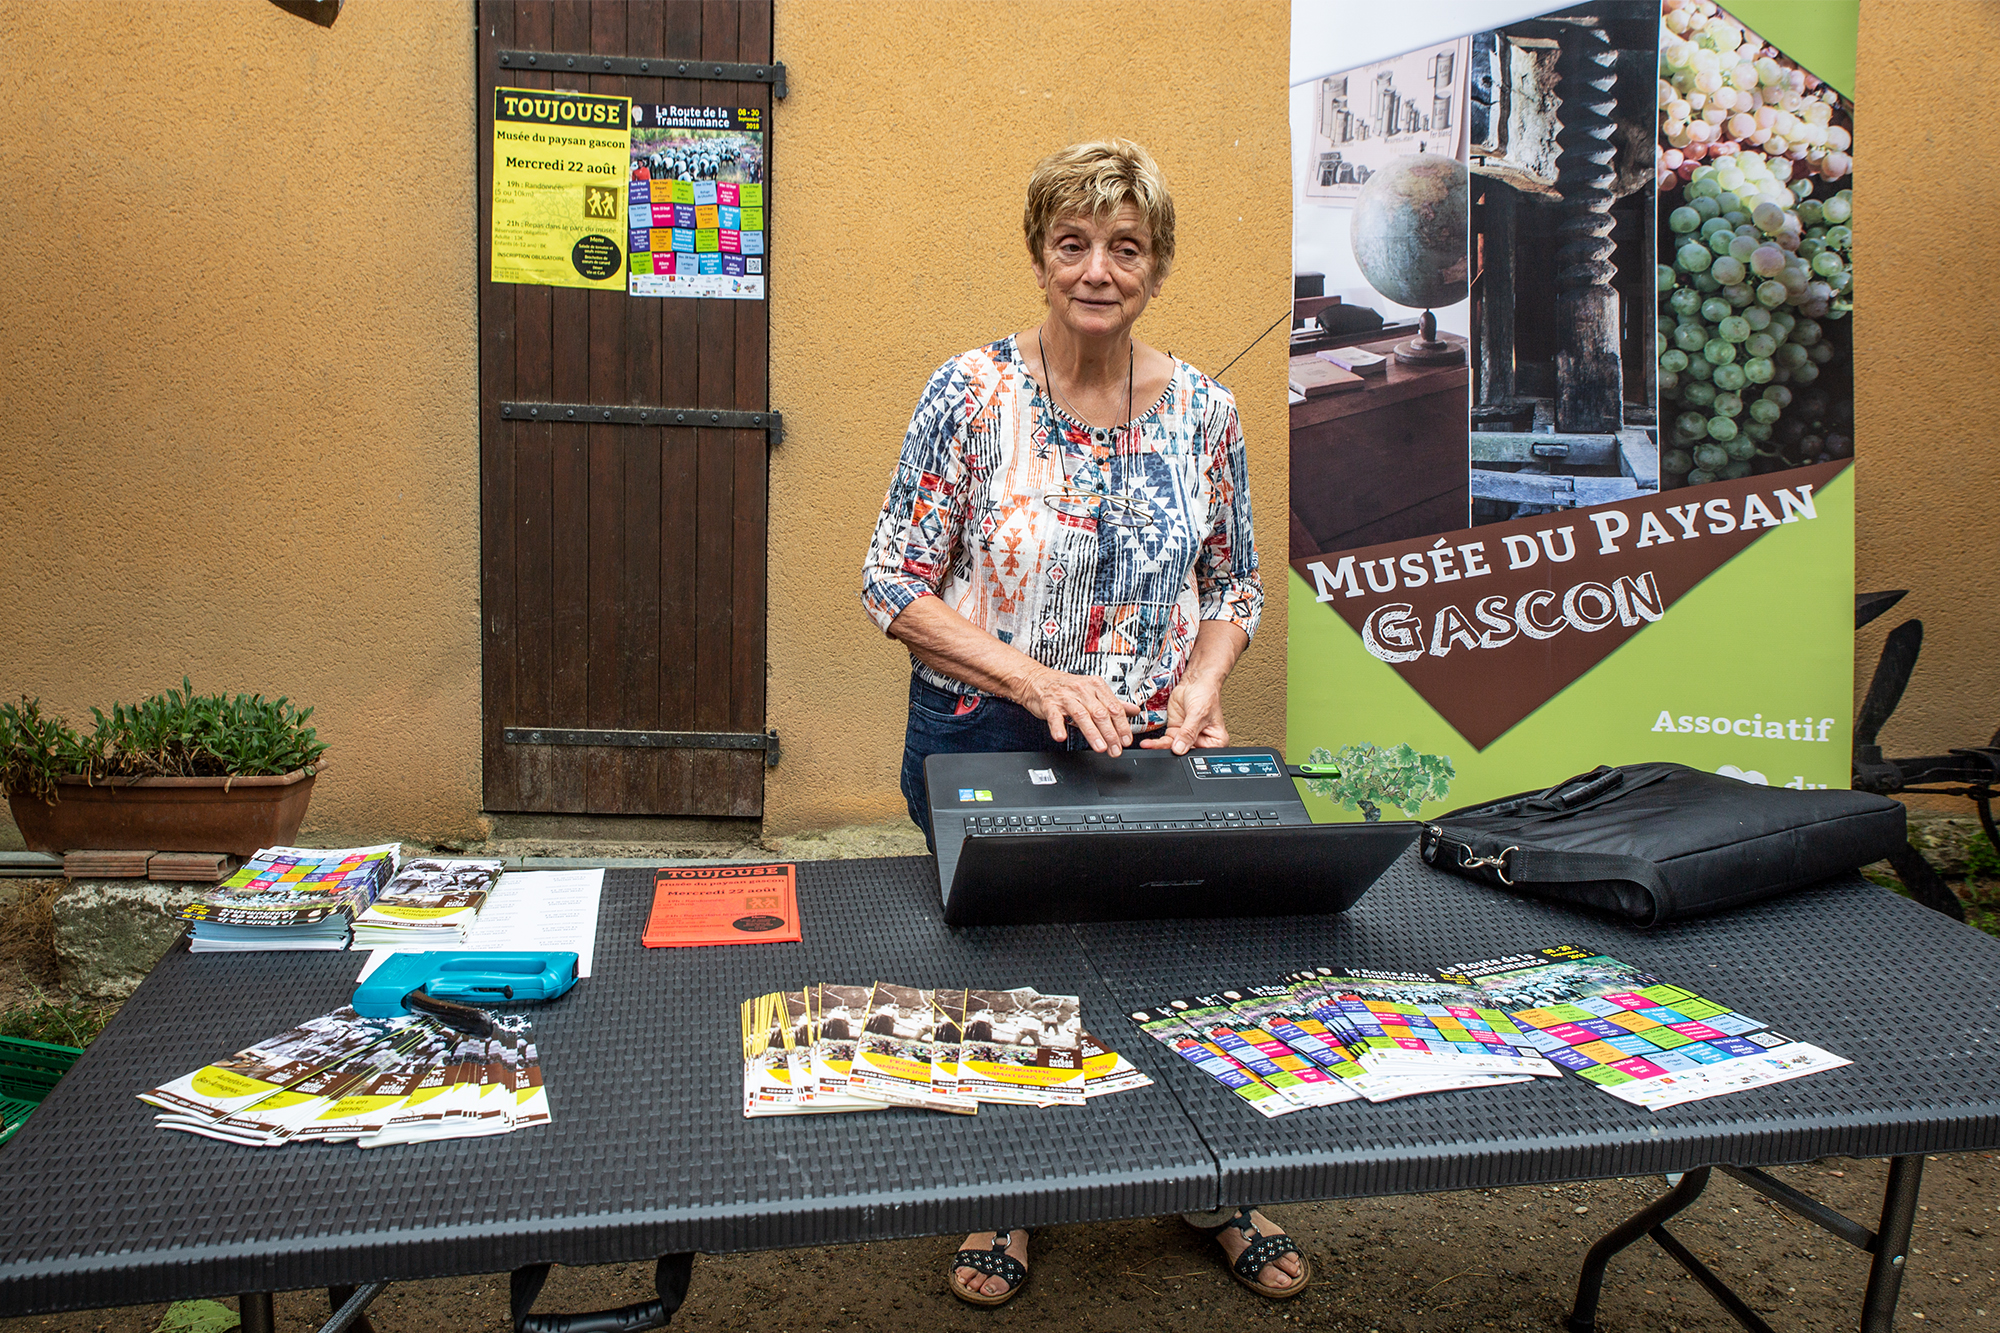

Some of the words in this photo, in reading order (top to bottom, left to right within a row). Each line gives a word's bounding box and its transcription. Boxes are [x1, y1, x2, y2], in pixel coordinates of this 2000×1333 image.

[504, 97, 620, 124] TOUJOUSE
[656, 105, 668, 117] La
[670, 106, 701, 119] Route
[703, 106, 716, 118] de
[718, 107, 728, 119] la
[738, 108, 747, 116] 08
[656, 115, 730, 128] Transhumance
[497, 131, 530, 141] Musée
[532, 133, 545, 142] du
[548, 135, 586, 146] paysan
[589, 138, 625, 148] gascon
[506, 157, 564, 171] Mercredi
[568, 161, 583, 172] 22
[587, 162, 617, 175] août
[525, 182, 565, 190] Randonnées
[514, 190, 534, 198] 10km)
[524, 221, 544, 229] Repas
[1306, 536, 1492, 604] MUSÉE
[1502, 524, 1577, 570] DU
[1589, 483, 1818, 556] PAYSAN
[1361, 570, 1666, 664] GASCON
[1651, 709, 1835, 742] Associatif
[668, 867, 778, 879] TOUJOUSE
[1436, 966, 1459, 975] La
[1455, 958, 1501, 970] Route
[1501, 956, 1517, 964] de
[1516, 953, 1536, 962] la
[984, 1080, 1018, 1088] TOUJOUSE
